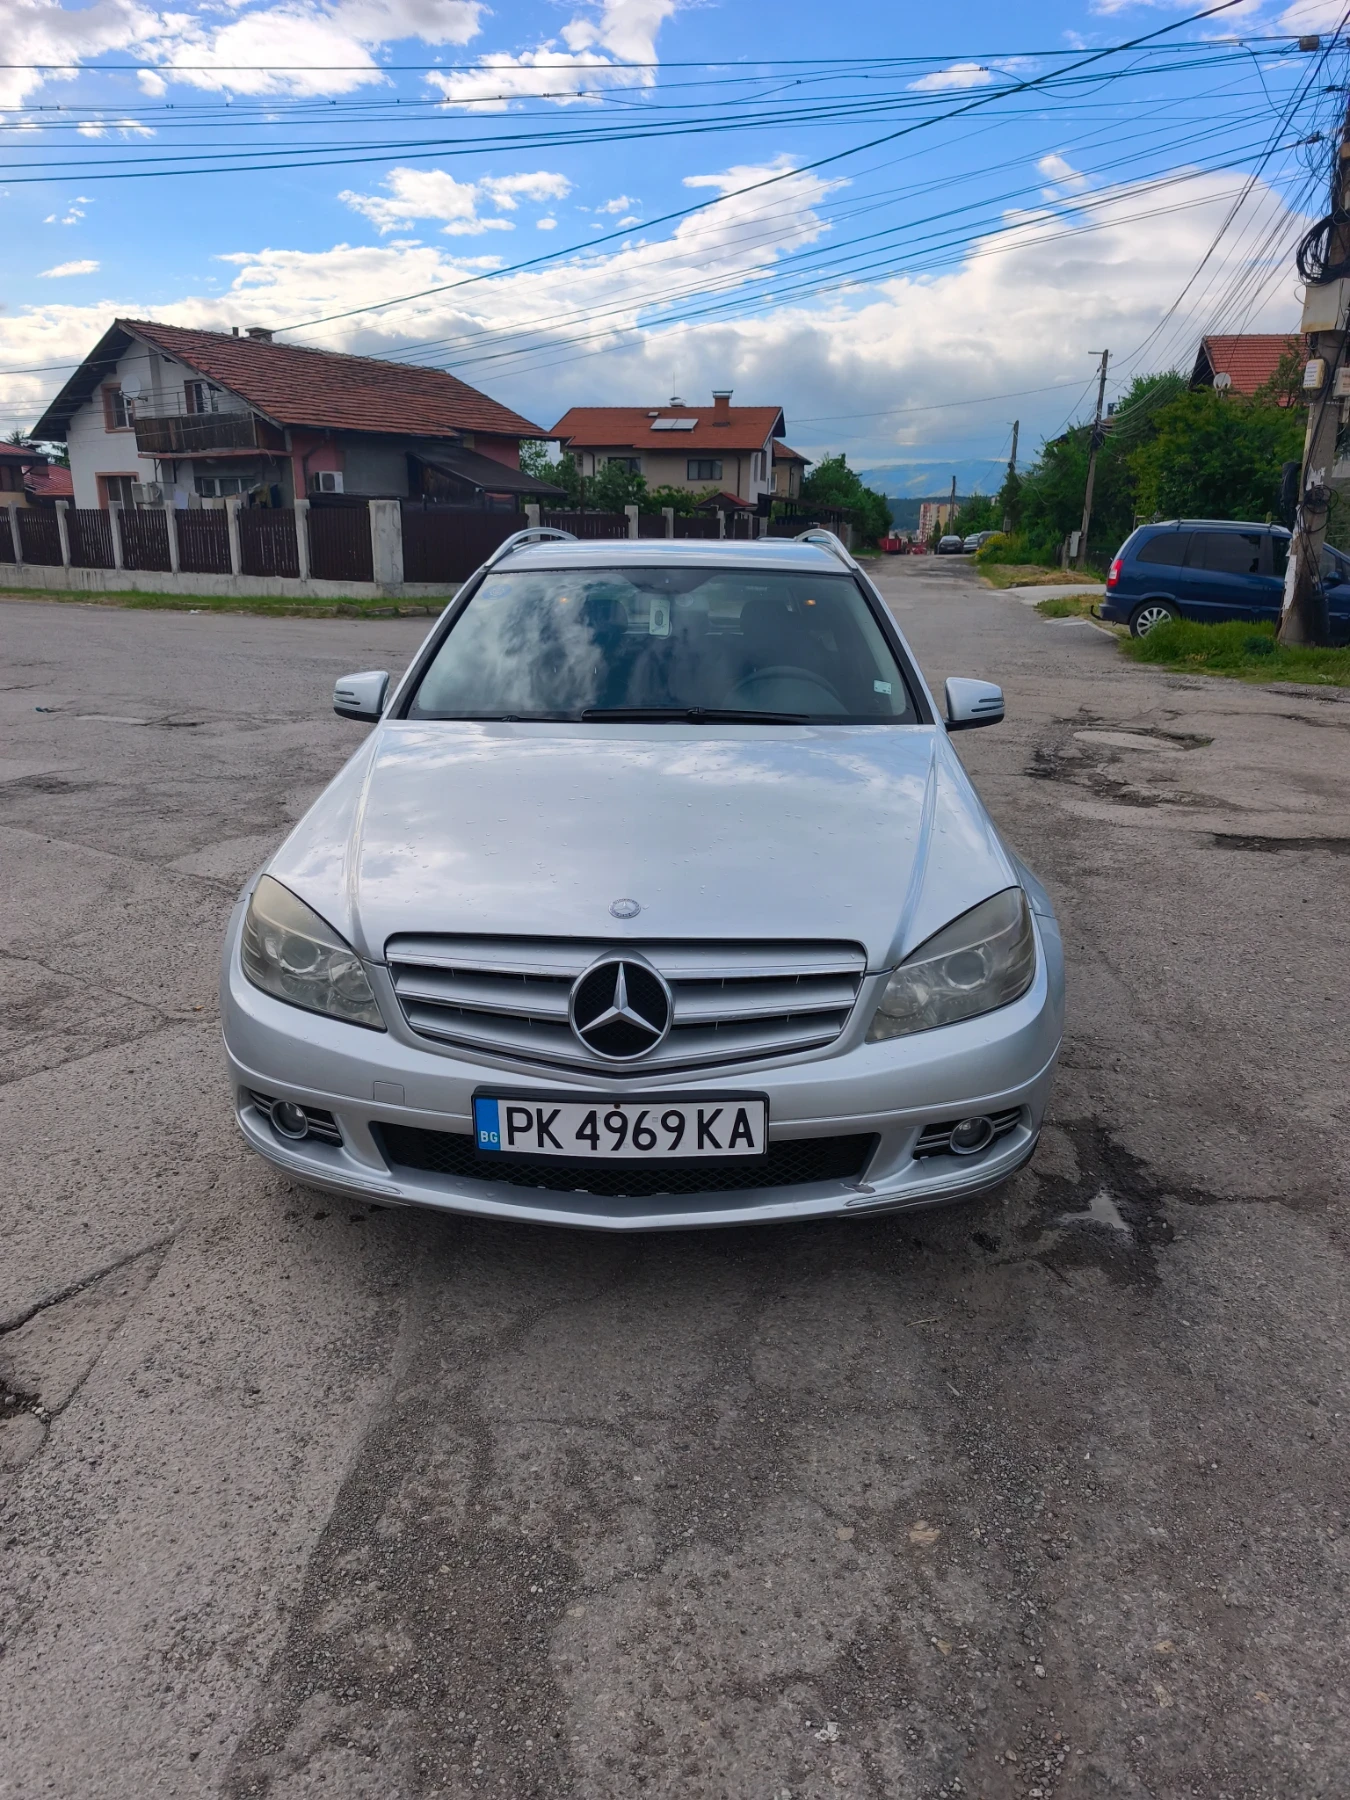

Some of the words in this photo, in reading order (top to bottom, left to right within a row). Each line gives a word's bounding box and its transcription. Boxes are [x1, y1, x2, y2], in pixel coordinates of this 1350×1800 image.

[480, 1130, 498, 1143] BG
[506, 1106, 563, 1149] PK
[575, 1109, 686, 1151] 4969
[697, 1108, 755, 1150] KA
